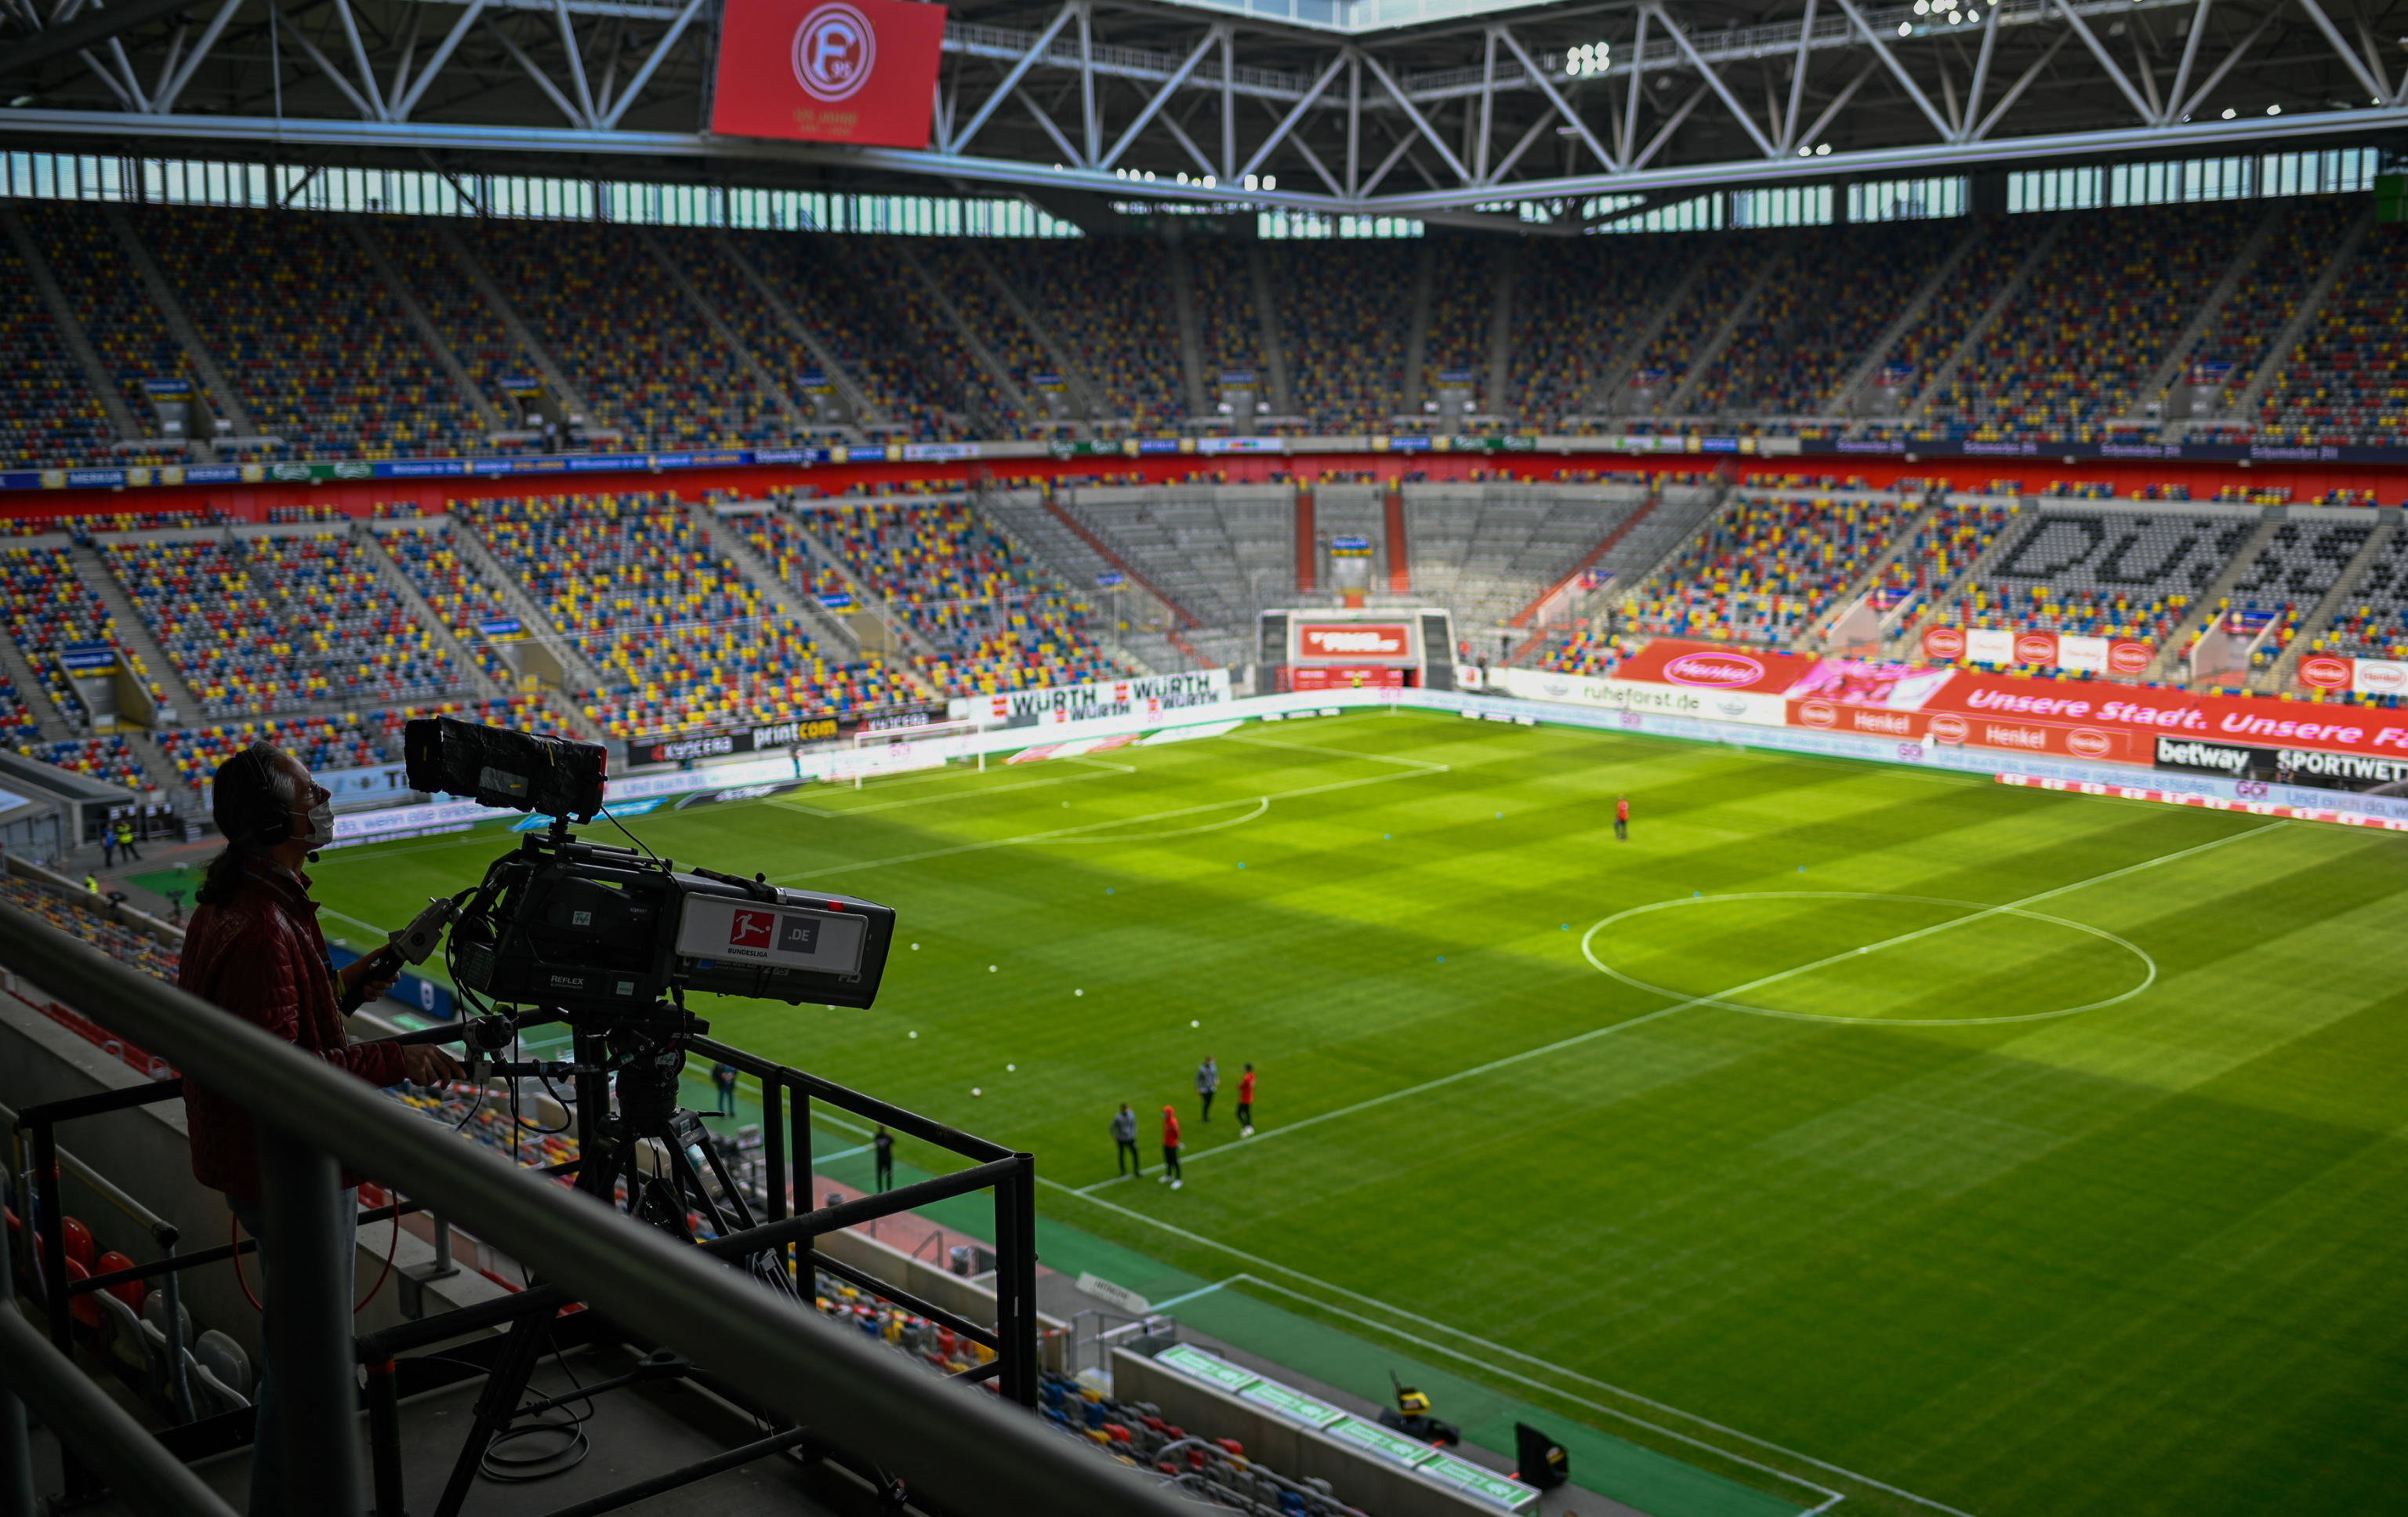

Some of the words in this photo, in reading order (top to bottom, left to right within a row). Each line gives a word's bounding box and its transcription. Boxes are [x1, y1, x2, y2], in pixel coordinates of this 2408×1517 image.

[69, 471, 122, 484] MERKUR
[187, 468, 236, 481] MERKUR
[1673, 658, 1757, 681] Henkel
[1583, 684, 1699, 710] ruheforst.de
[1854, 711, 1910, 734] Henkel
[1967, 688, 2091, 717] Unsere
[2095, 700, 2207, 730] Stadt.
[2221, 713, 2364, 744] Unsere
[663, 736, 734, 760] KYOCERA
[1986, 726, 2046, 749] Henkel
[2157, 738, 2250, 772] betway
[2286, 789, 2318, 806] Und
[727, 947, 768, 958] BUNDESLIGA
[550, 974, 584, 985] REFLEX
